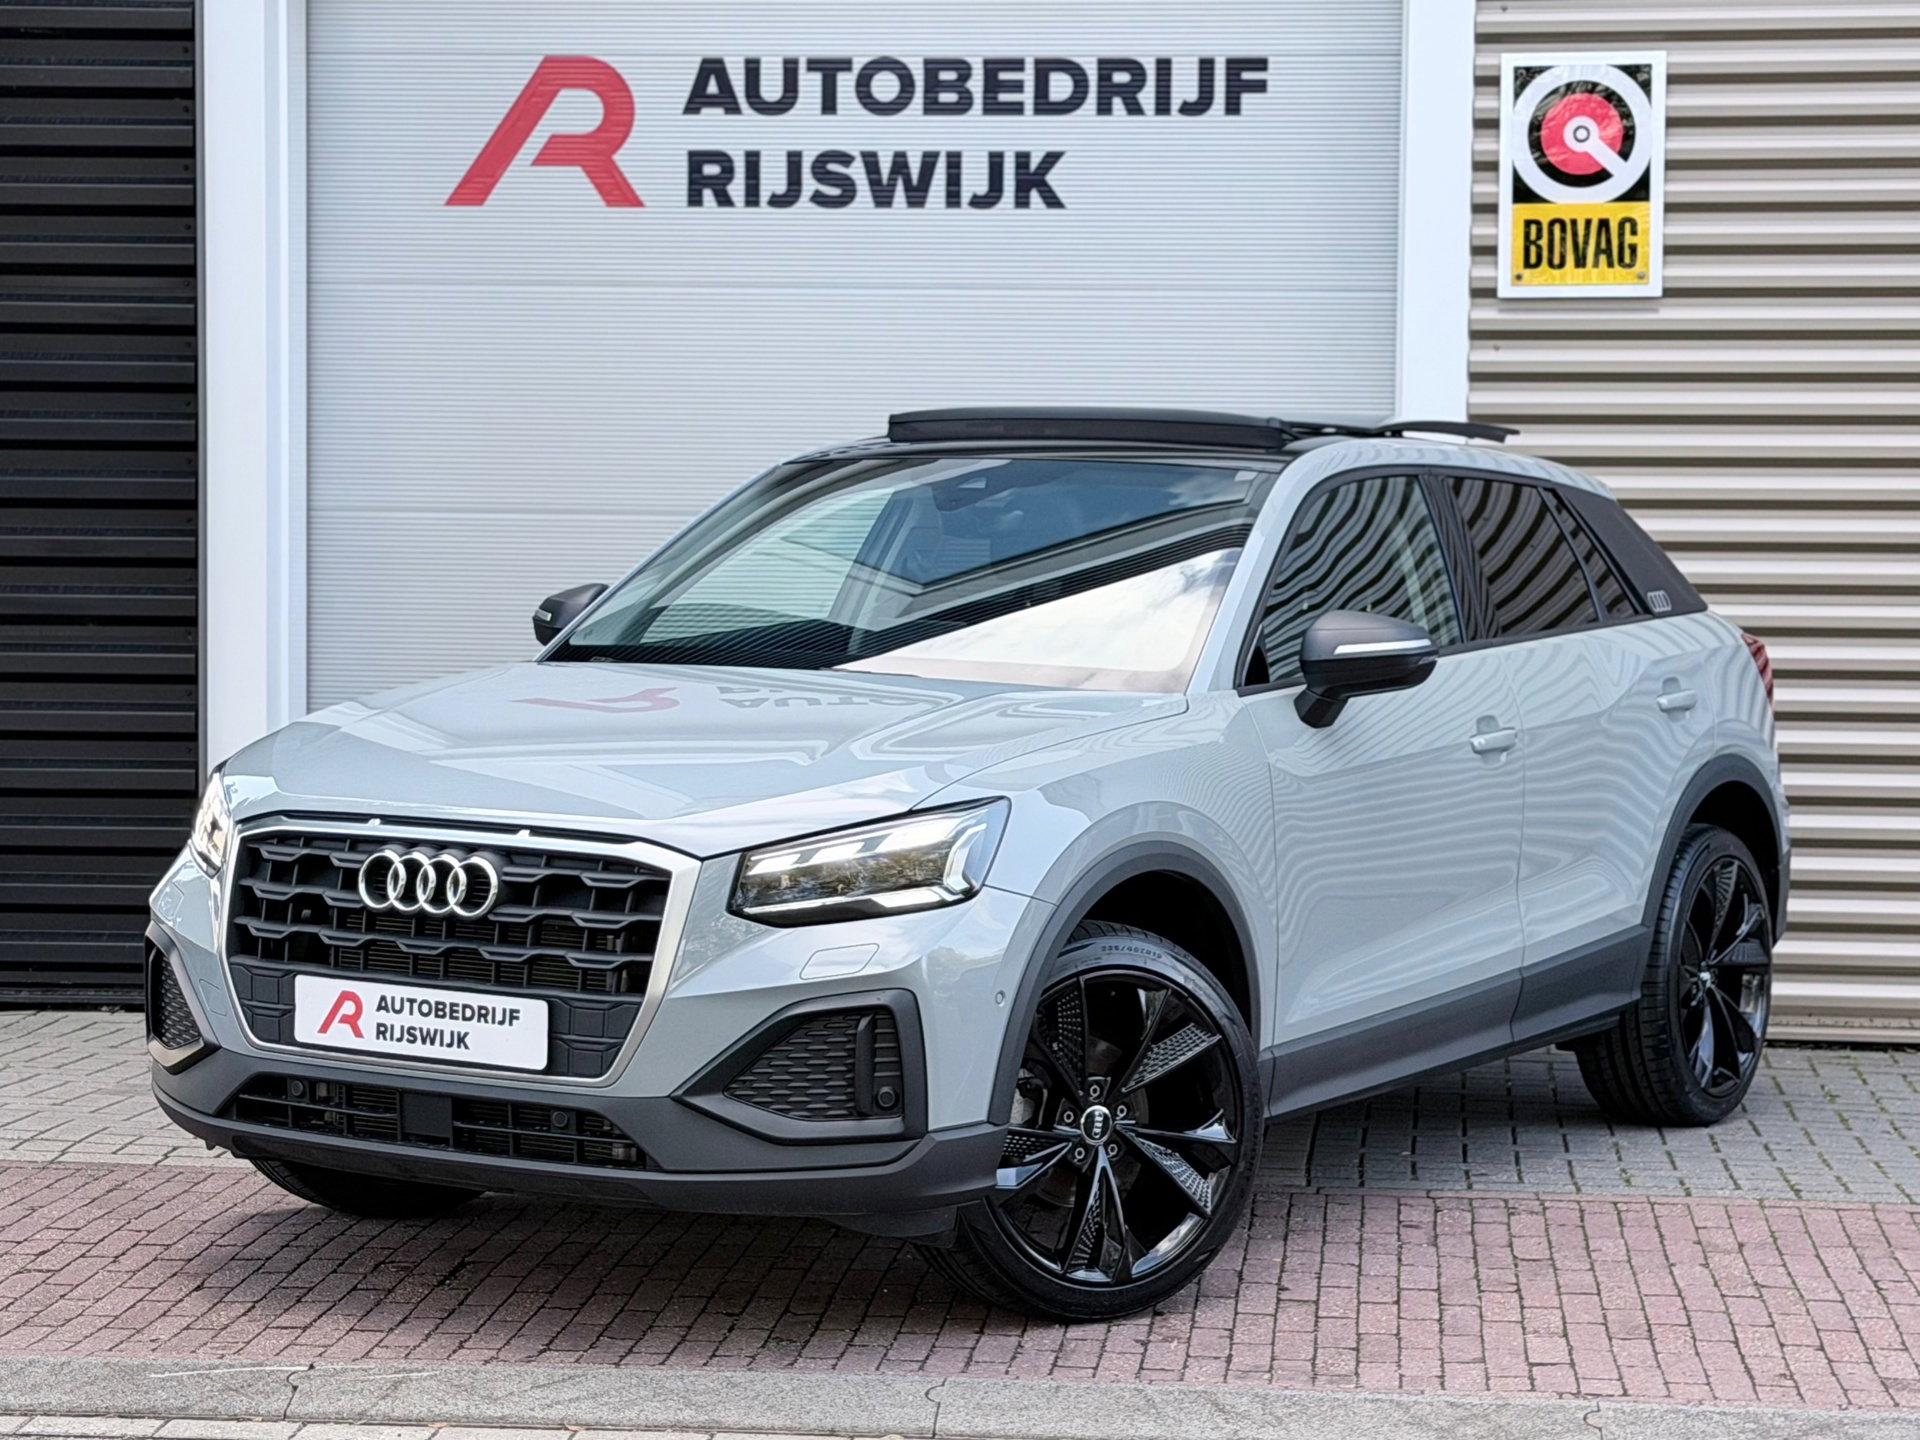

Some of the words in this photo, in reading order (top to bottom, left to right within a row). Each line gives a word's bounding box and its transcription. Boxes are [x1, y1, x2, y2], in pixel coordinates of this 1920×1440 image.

[683, 56, 1269, 117] AUTOBEDRIJF
[686, 150, 1067, 210] RIJSWIJK
[1522, 217, 1639, 270] BOVAG
[375, 994, 521, 1027] AUTOBEDRIJF
[375, 1022, 470, 1050] RIJSWIJK
